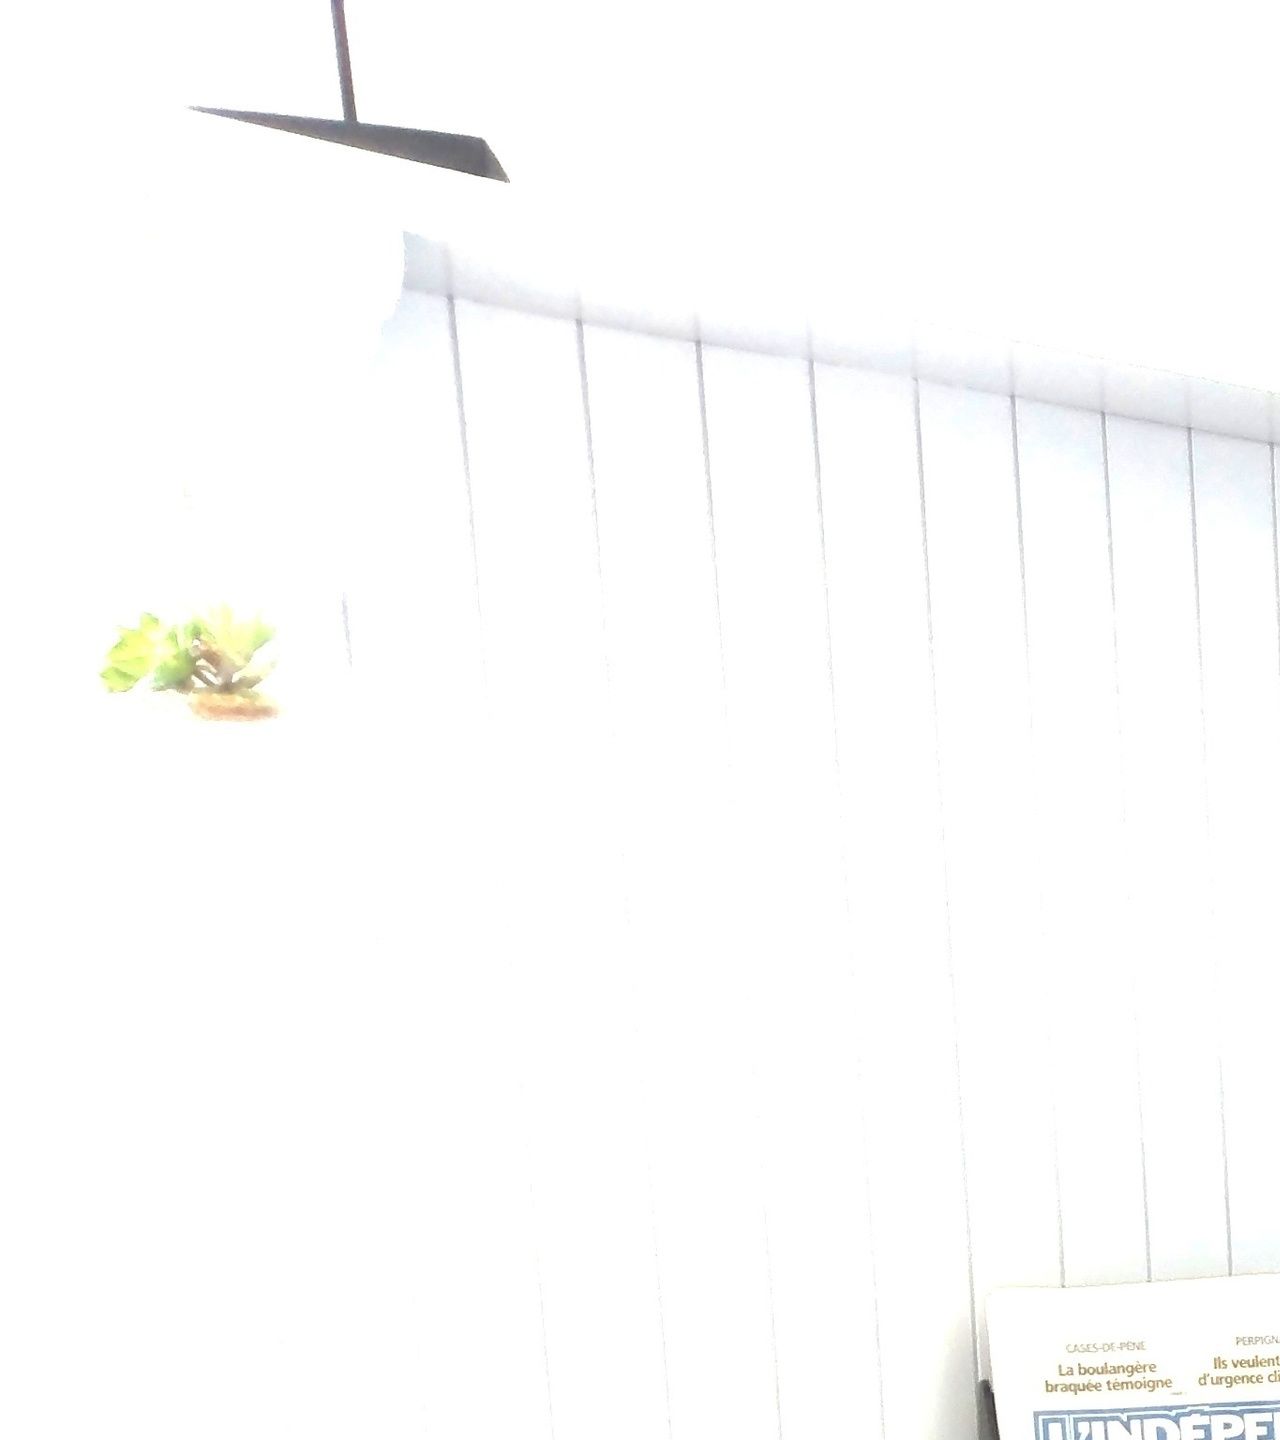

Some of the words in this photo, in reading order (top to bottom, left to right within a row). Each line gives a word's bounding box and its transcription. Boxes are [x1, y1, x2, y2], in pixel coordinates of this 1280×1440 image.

[1058, 1363, 1075, 1377] La
[1078, 1361, 1158, 1379] boulangère
[1213, 1356, 1229, 1370] Ils
[1231, 1355, 1280, 1369] veulent
[1045, 1379, 1103, 1396] braquée
[1106, 1377, 1173, 1394] témoigne
[1198, 1372, 1264, 1389] d'urgence
